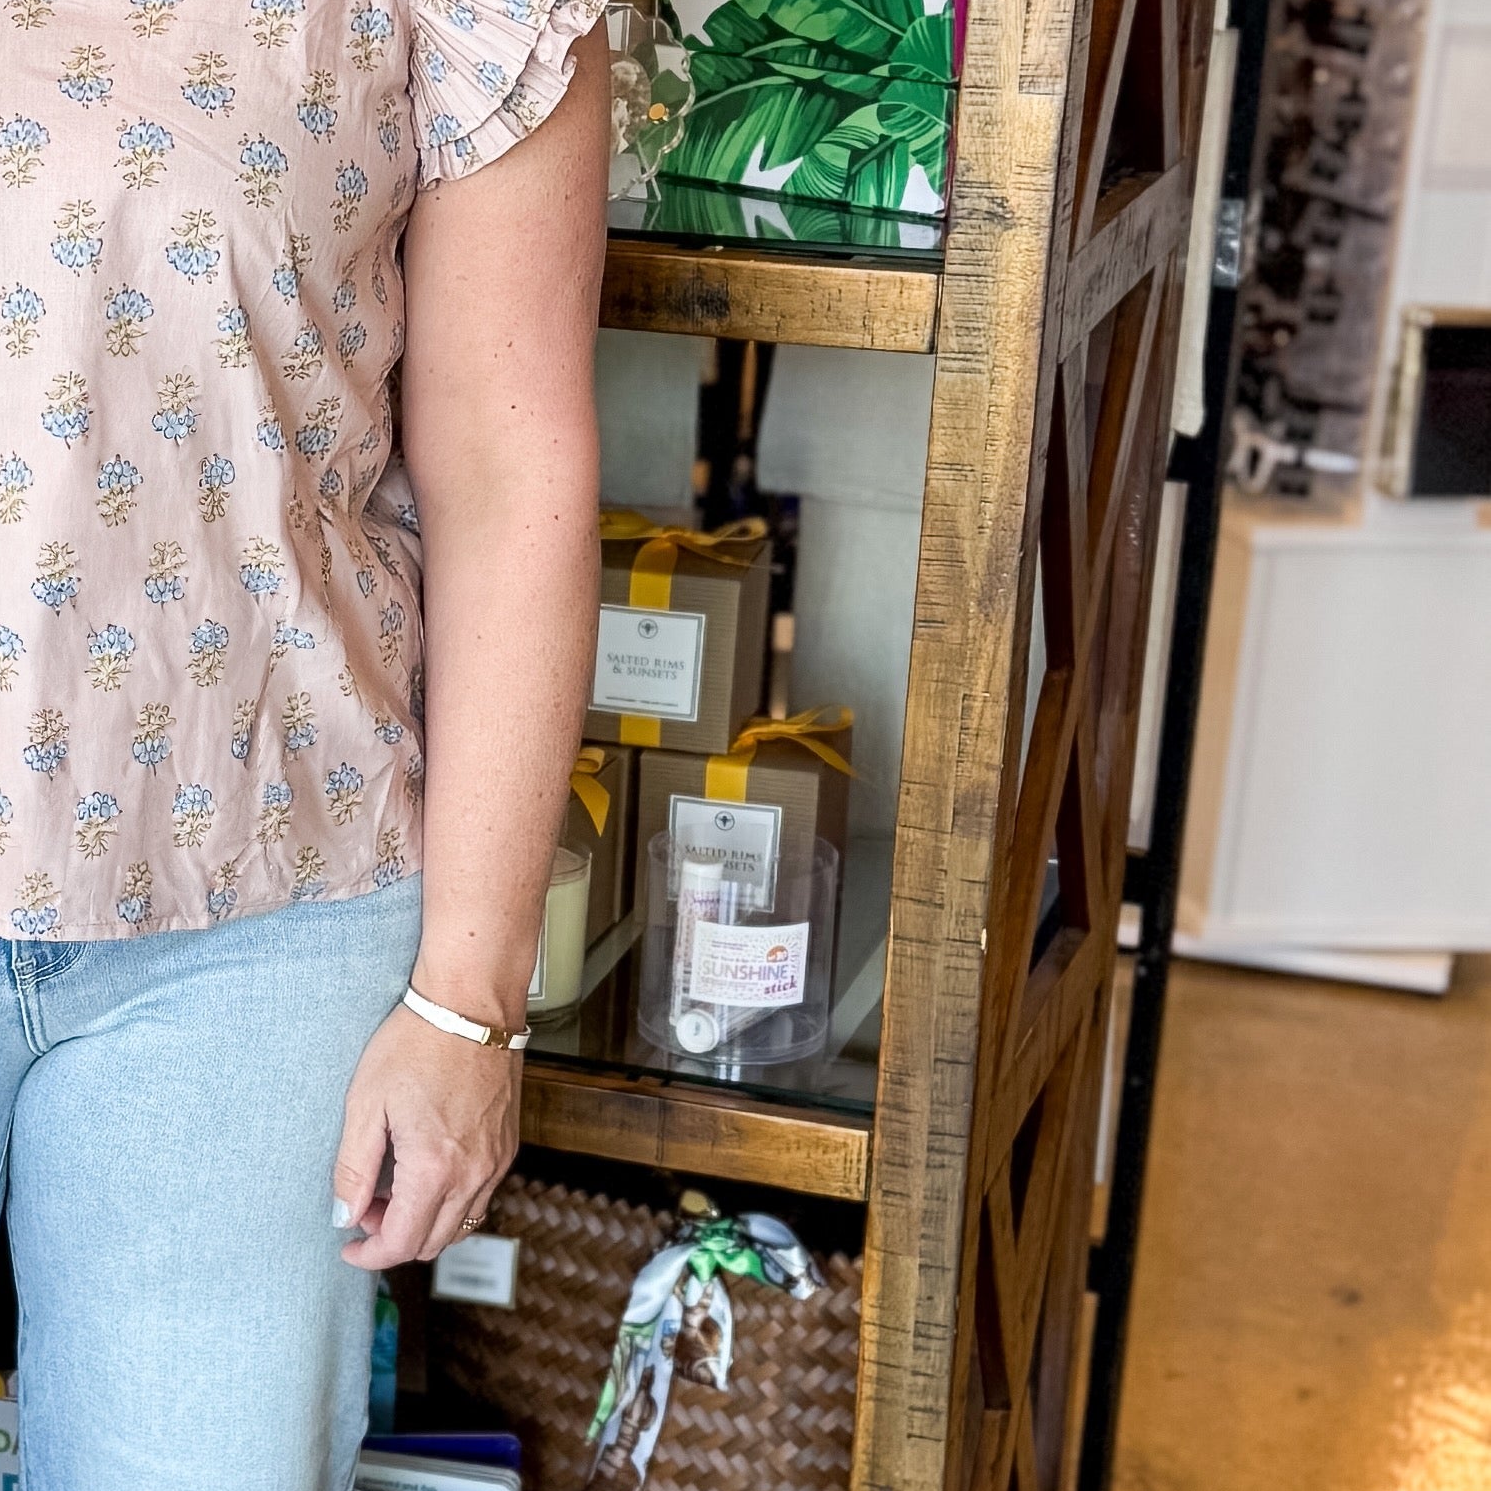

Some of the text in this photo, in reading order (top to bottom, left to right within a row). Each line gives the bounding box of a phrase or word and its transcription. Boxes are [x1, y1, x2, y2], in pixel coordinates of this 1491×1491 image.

[606, 653, 685, 671] SALTED RIMS
[613, 665, 678, 681] & SUNSETS
[685, 845, 727, 858] SALTED
[702, 960, 789, 982] SUNSHINE
[764, 975, 798, 995] stick
